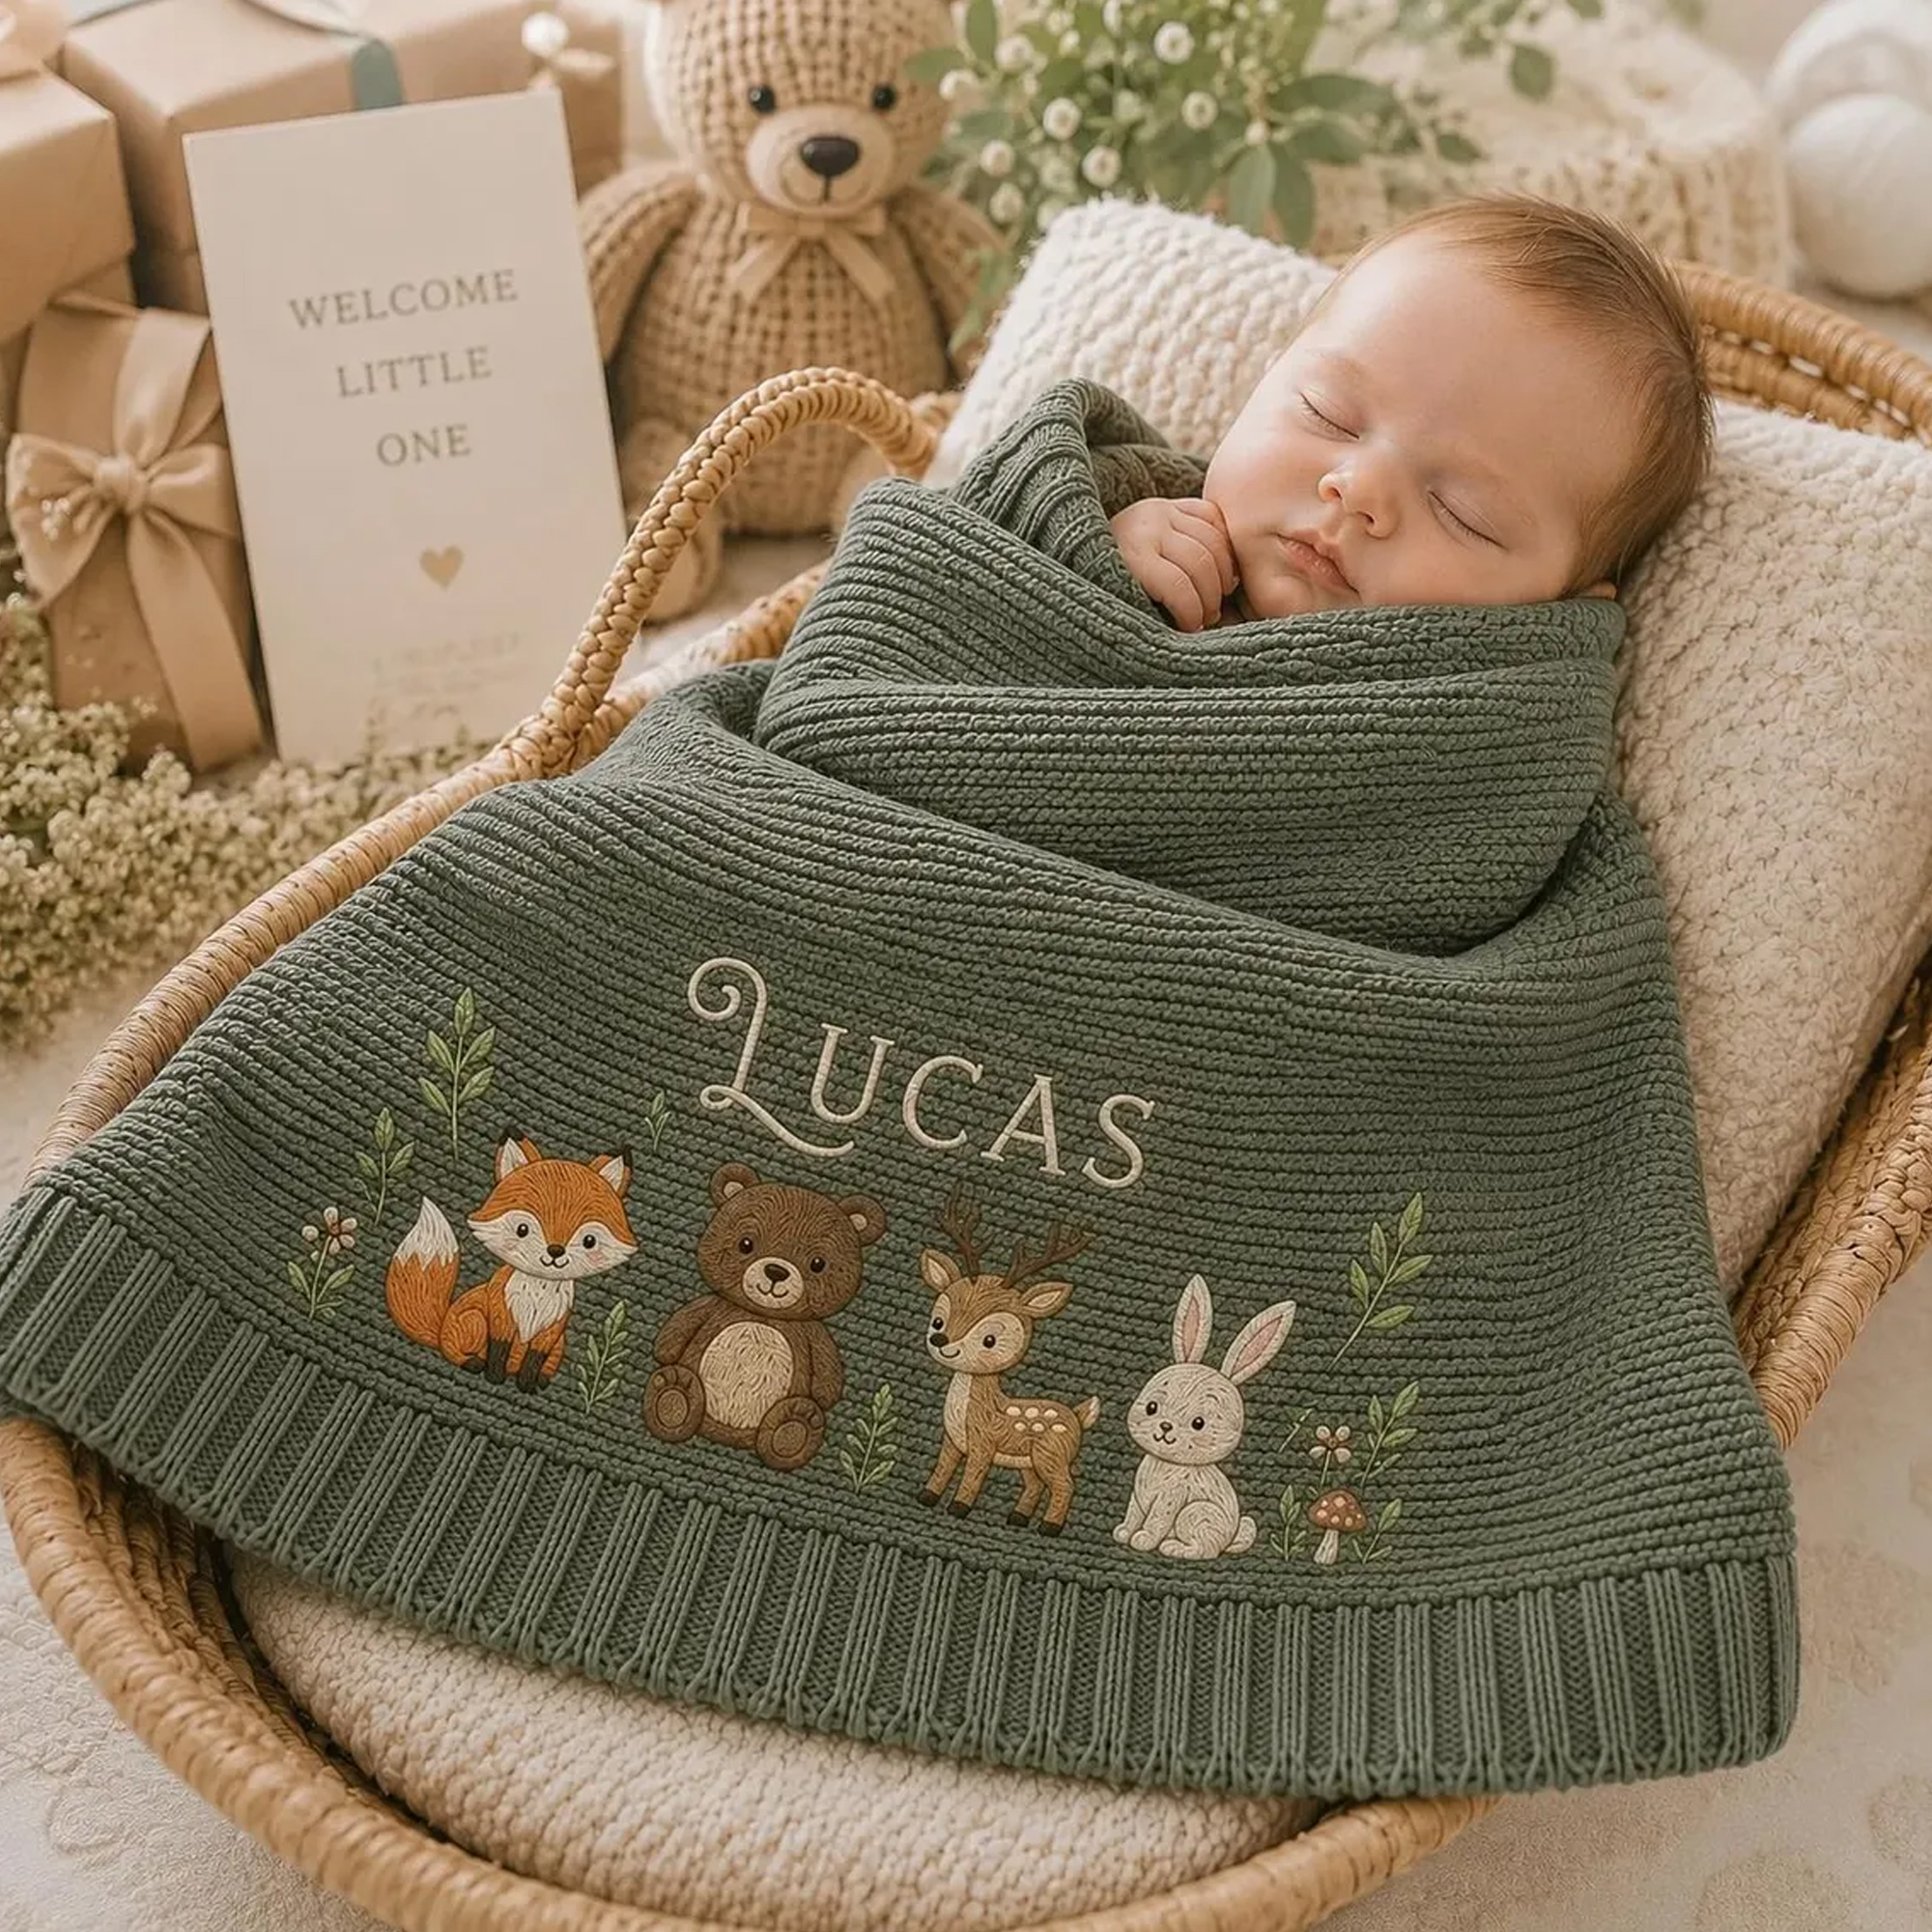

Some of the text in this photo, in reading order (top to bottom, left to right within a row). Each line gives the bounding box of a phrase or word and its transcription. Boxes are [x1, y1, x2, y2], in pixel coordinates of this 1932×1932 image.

[288, 269, 518, 329] WELCOME
[336, 345, 493, 398] LITTLE
[377, 423, 471, 467] ONE
[687, 957, 1155, 1189] LUCAS
